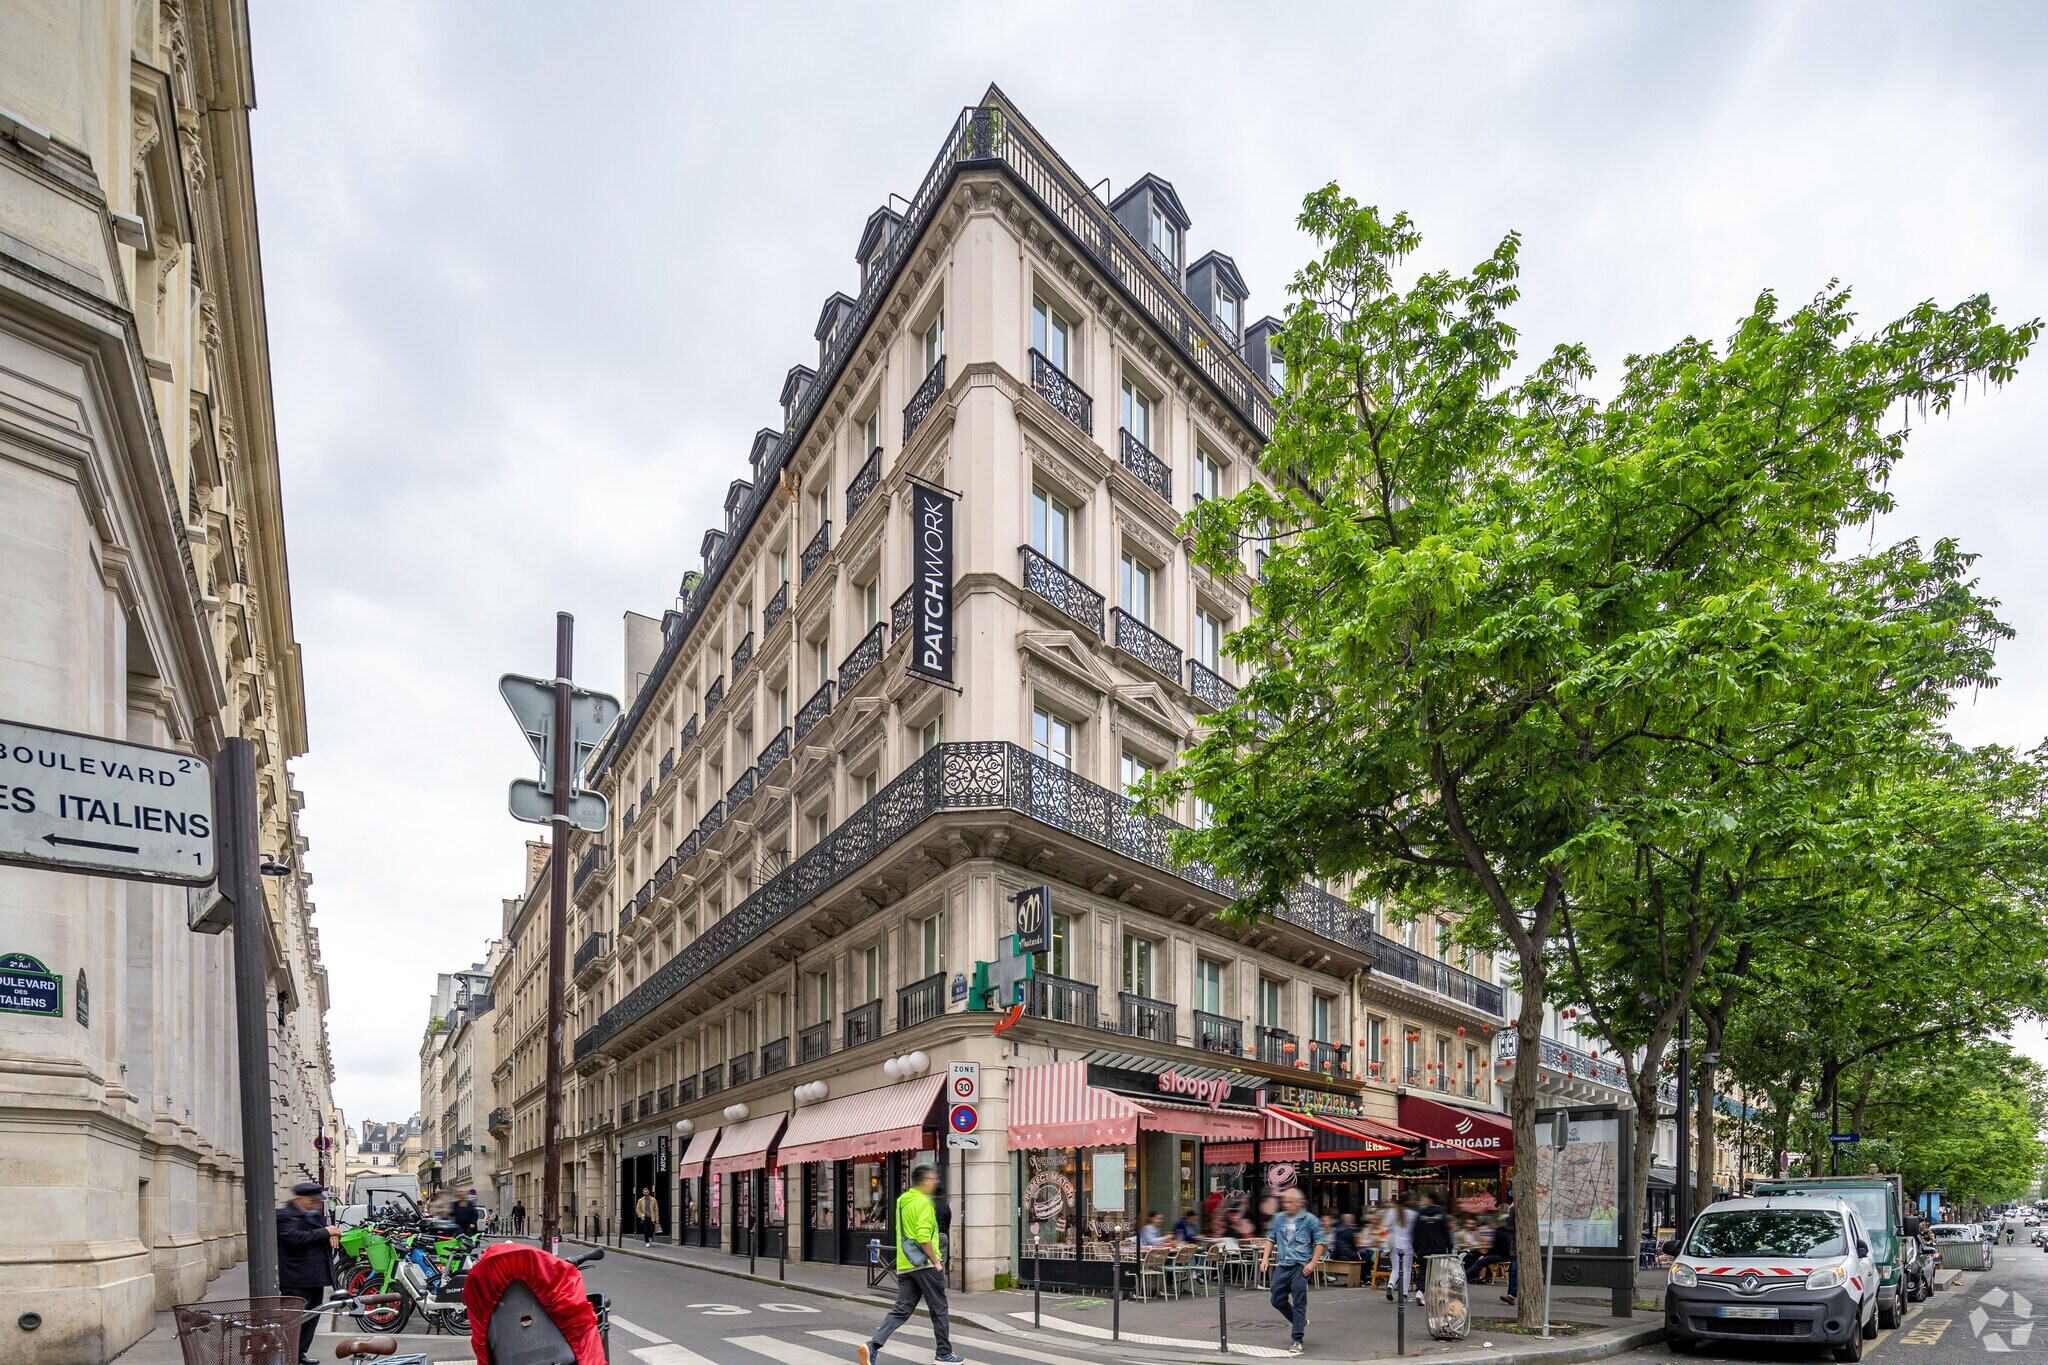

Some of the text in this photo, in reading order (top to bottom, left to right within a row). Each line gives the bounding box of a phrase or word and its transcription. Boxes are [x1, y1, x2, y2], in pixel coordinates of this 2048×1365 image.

[924, 497, 943, 671] PATCHWORK
[178, 759, 201, 774] 2e
[59, 793, 210, 839] ITALIENS
[193, 852, 202, 866] 1
[0, 976, 56, 990] ULEVARD
[954, 1065, 975, 1073] ZONE
[958, 1083, 970, 1092] 30
[1281, 1085, 1296, 1104] LE
[1811, 1111, 1826, 1119] BUS
[1365, 1140, 1373, 1152] LE
[1429, 1137, 1500, 1149] LA BRIGADE
[1314, 1159, 1391, 1173] BRASSERIE
[1025, 1172, 1049, 1200] PERFECT
